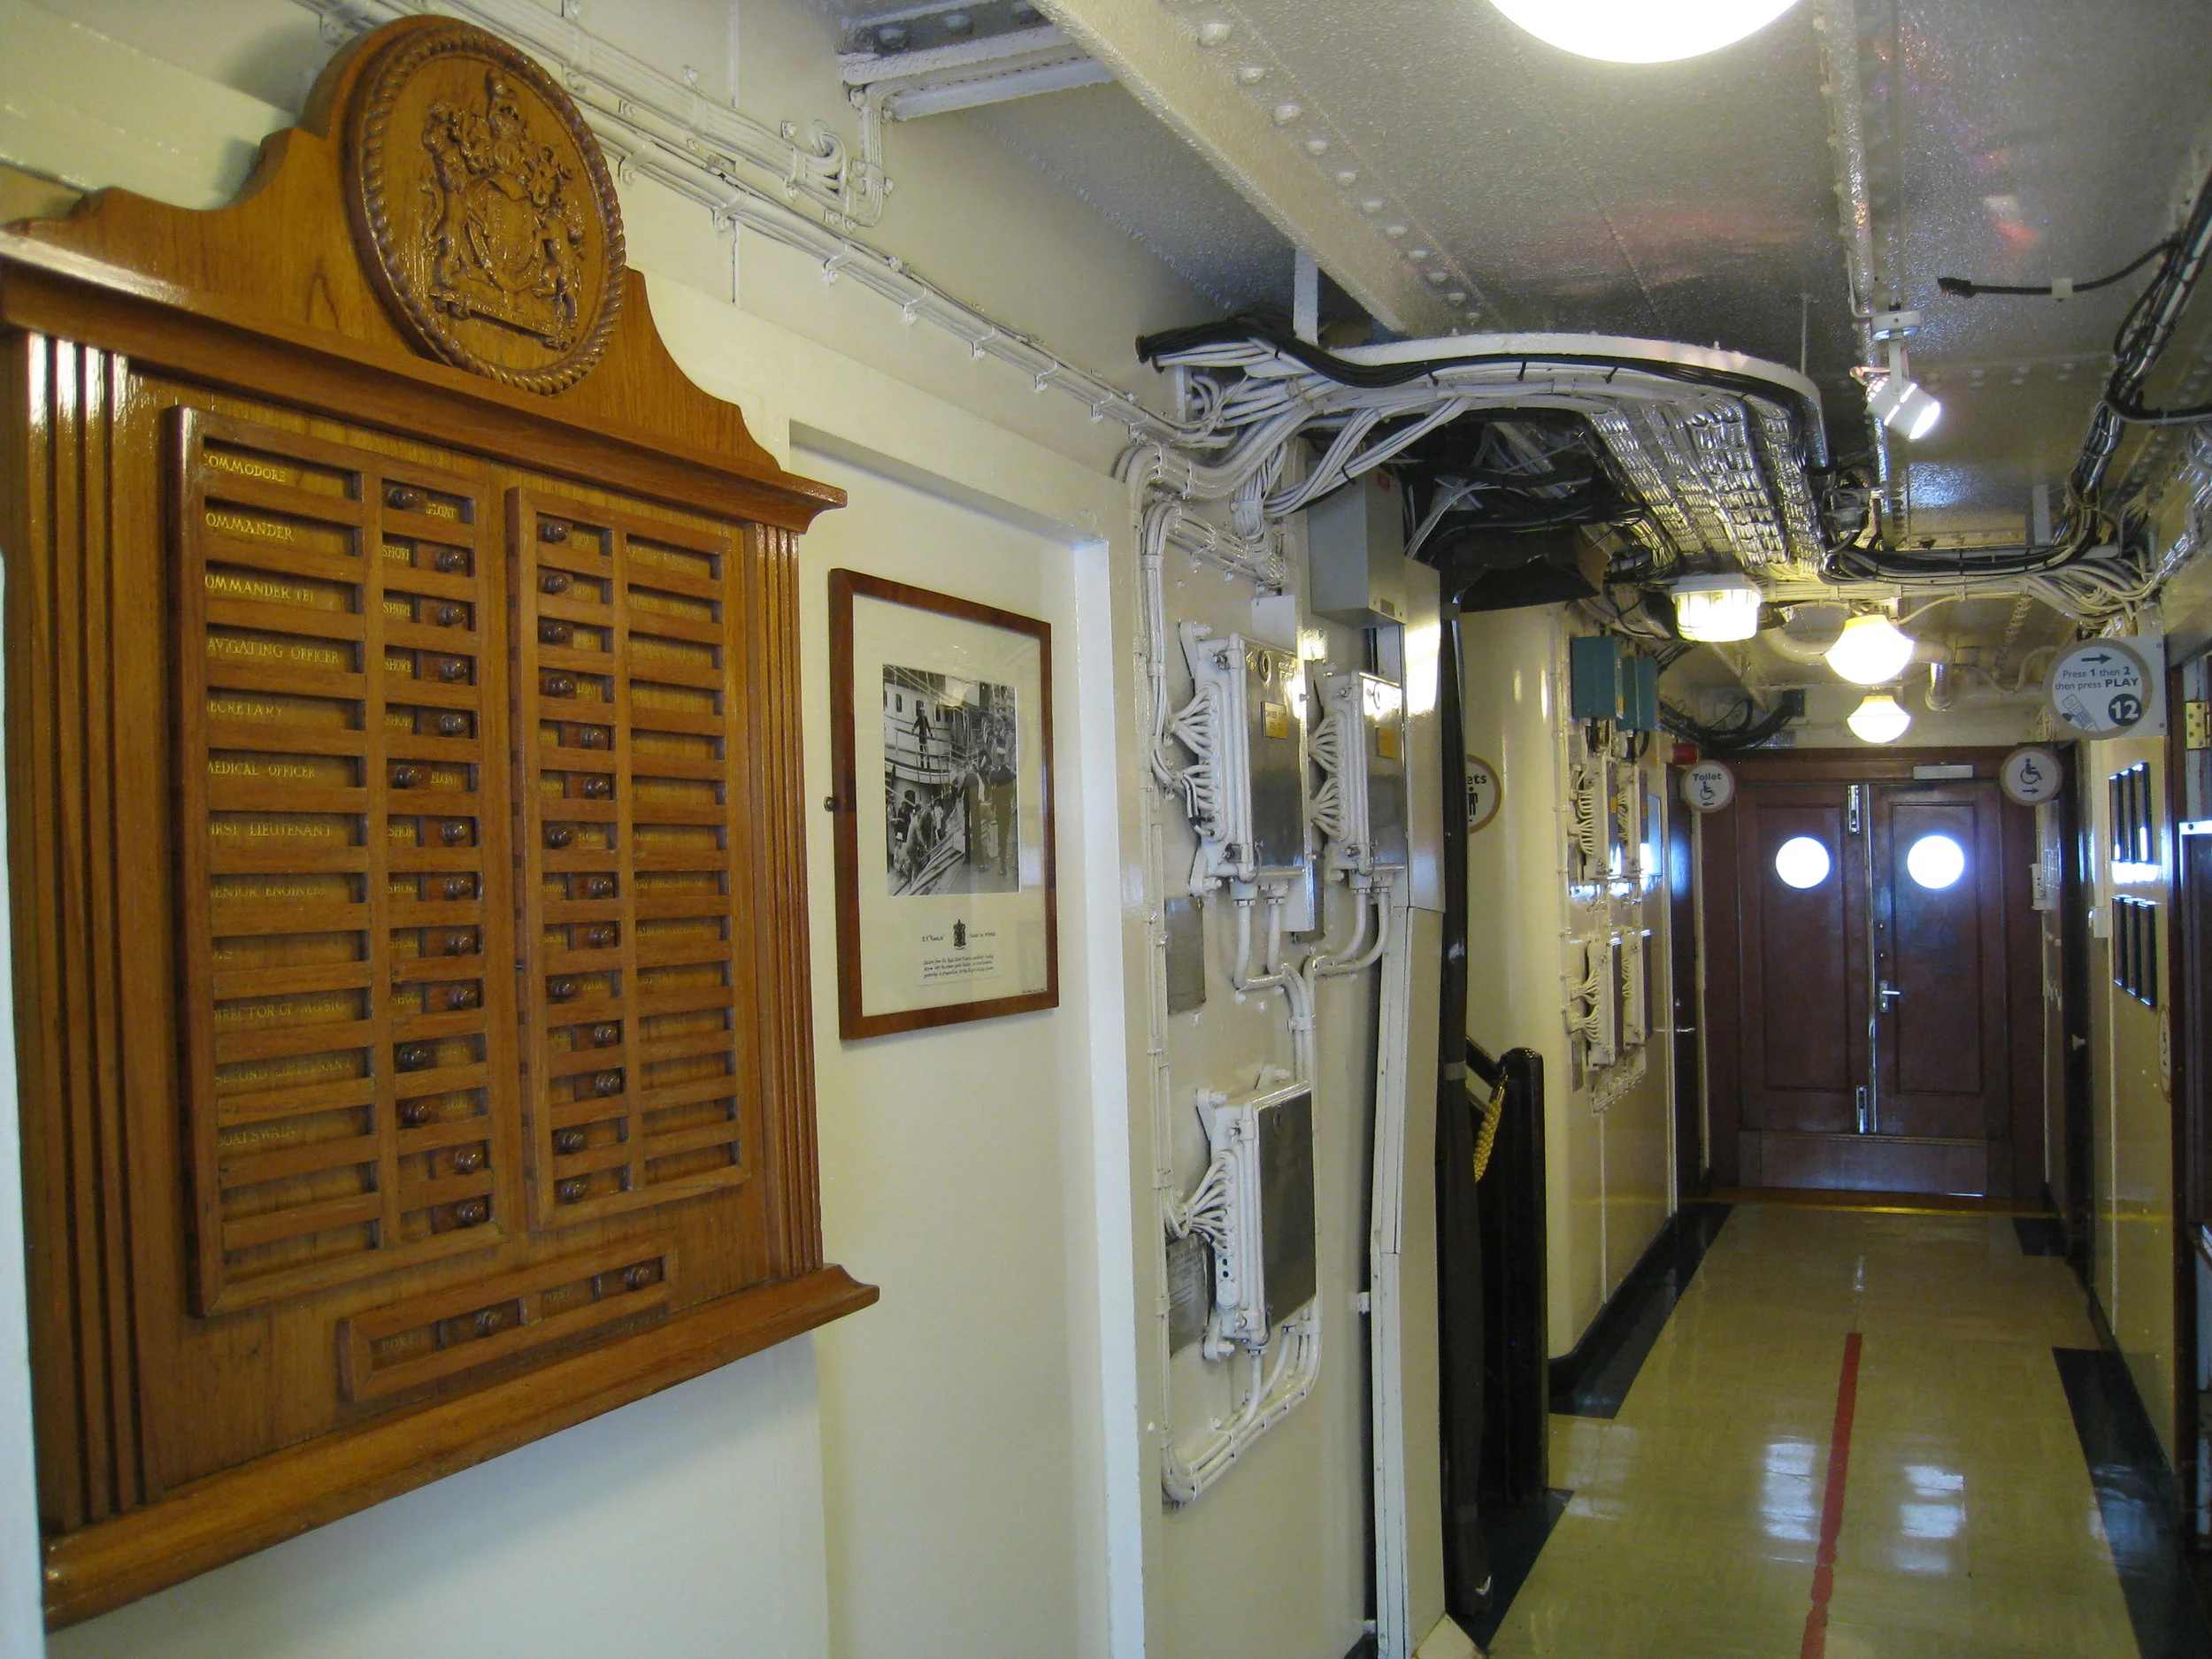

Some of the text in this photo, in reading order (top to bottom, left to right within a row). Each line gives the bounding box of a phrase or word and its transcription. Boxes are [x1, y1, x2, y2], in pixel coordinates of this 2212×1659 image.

[2062, 669, 2086, 679] Press
[2099, 667, 2120, 677] then
[2123, 666, 2131, 675] 2
[2055, 677, 2139, 691] then press PLAY
[2110, 699, 2139, 720] 12
[1692, 772, 1722, 782] Toilet
